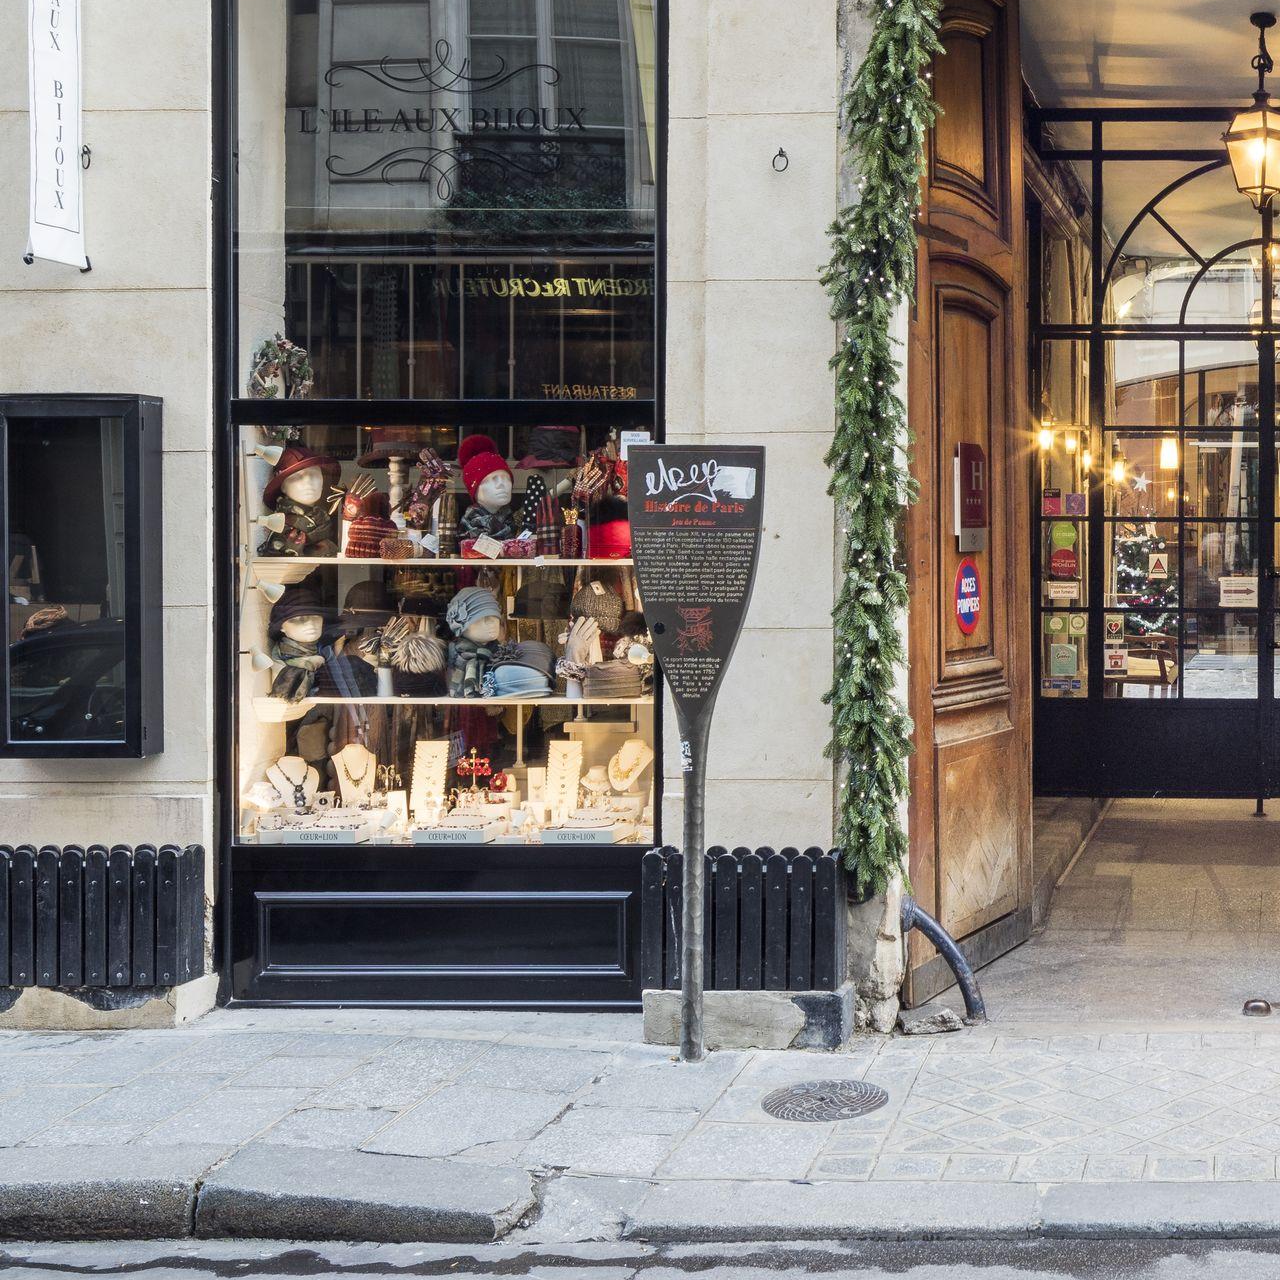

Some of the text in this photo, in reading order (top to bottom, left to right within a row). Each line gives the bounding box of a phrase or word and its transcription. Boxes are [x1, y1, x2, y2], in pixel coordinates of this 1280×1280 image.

[390, 107, 463, 134] AUX
[470, 106, 588, 133] BIJOUX
[53, 79, 65, 211] BIJOUX
[971, 461, 985, 491] H
[644, 499, 745, 513] Histoire de Paris
[961, 577, 976, 593] ACCES
[957, 596, 980, 614] POMPIERS
